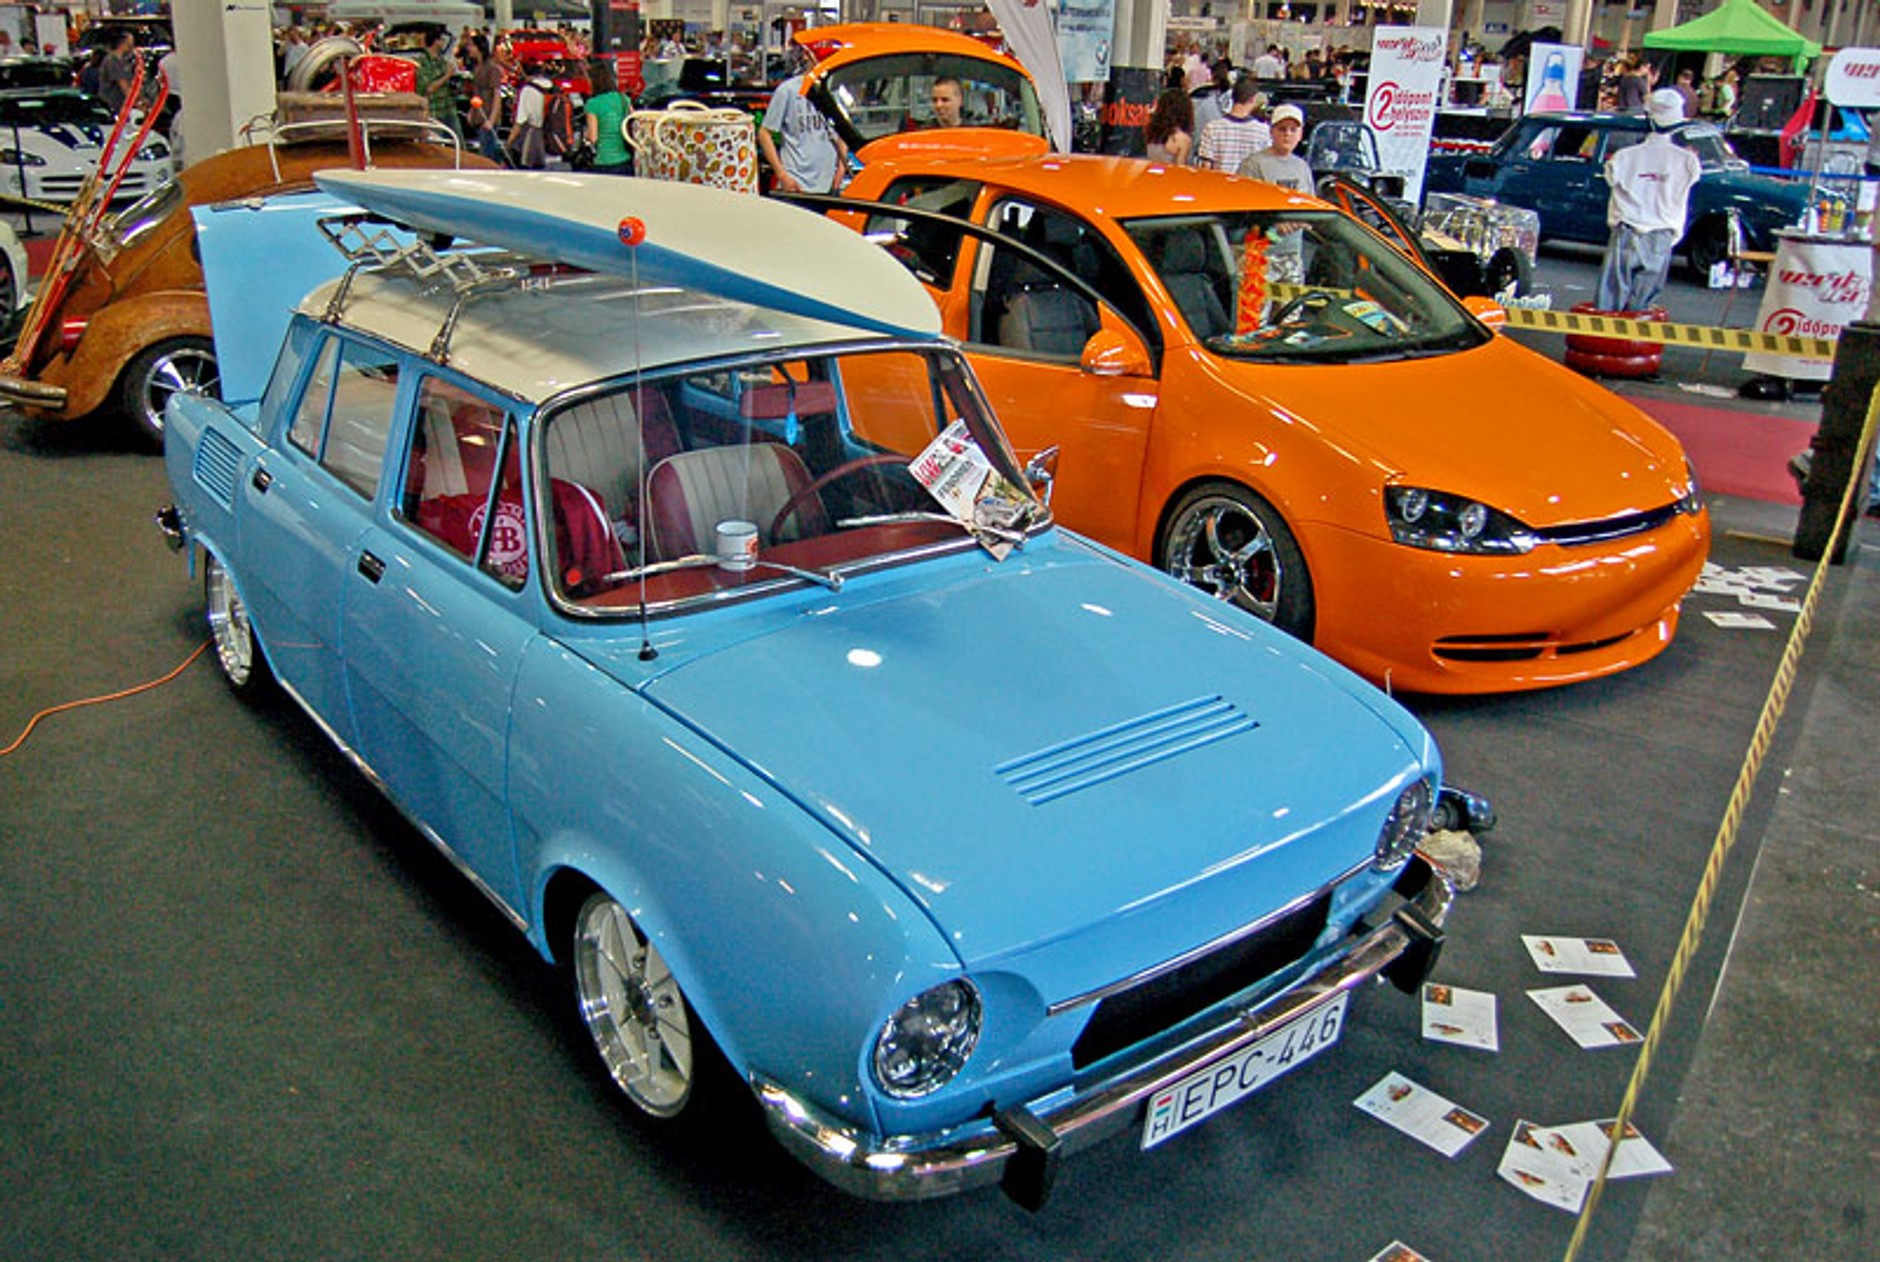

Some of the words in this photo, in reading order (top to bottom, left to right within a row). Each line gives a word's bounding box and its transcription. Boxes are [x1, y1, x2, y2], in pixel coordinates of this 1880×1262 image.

[1376, 89, 1393, 121] 2
[1181, 1005, 1340, 1123] EPC-446
[1151, 1116, 1170, 1140] H
